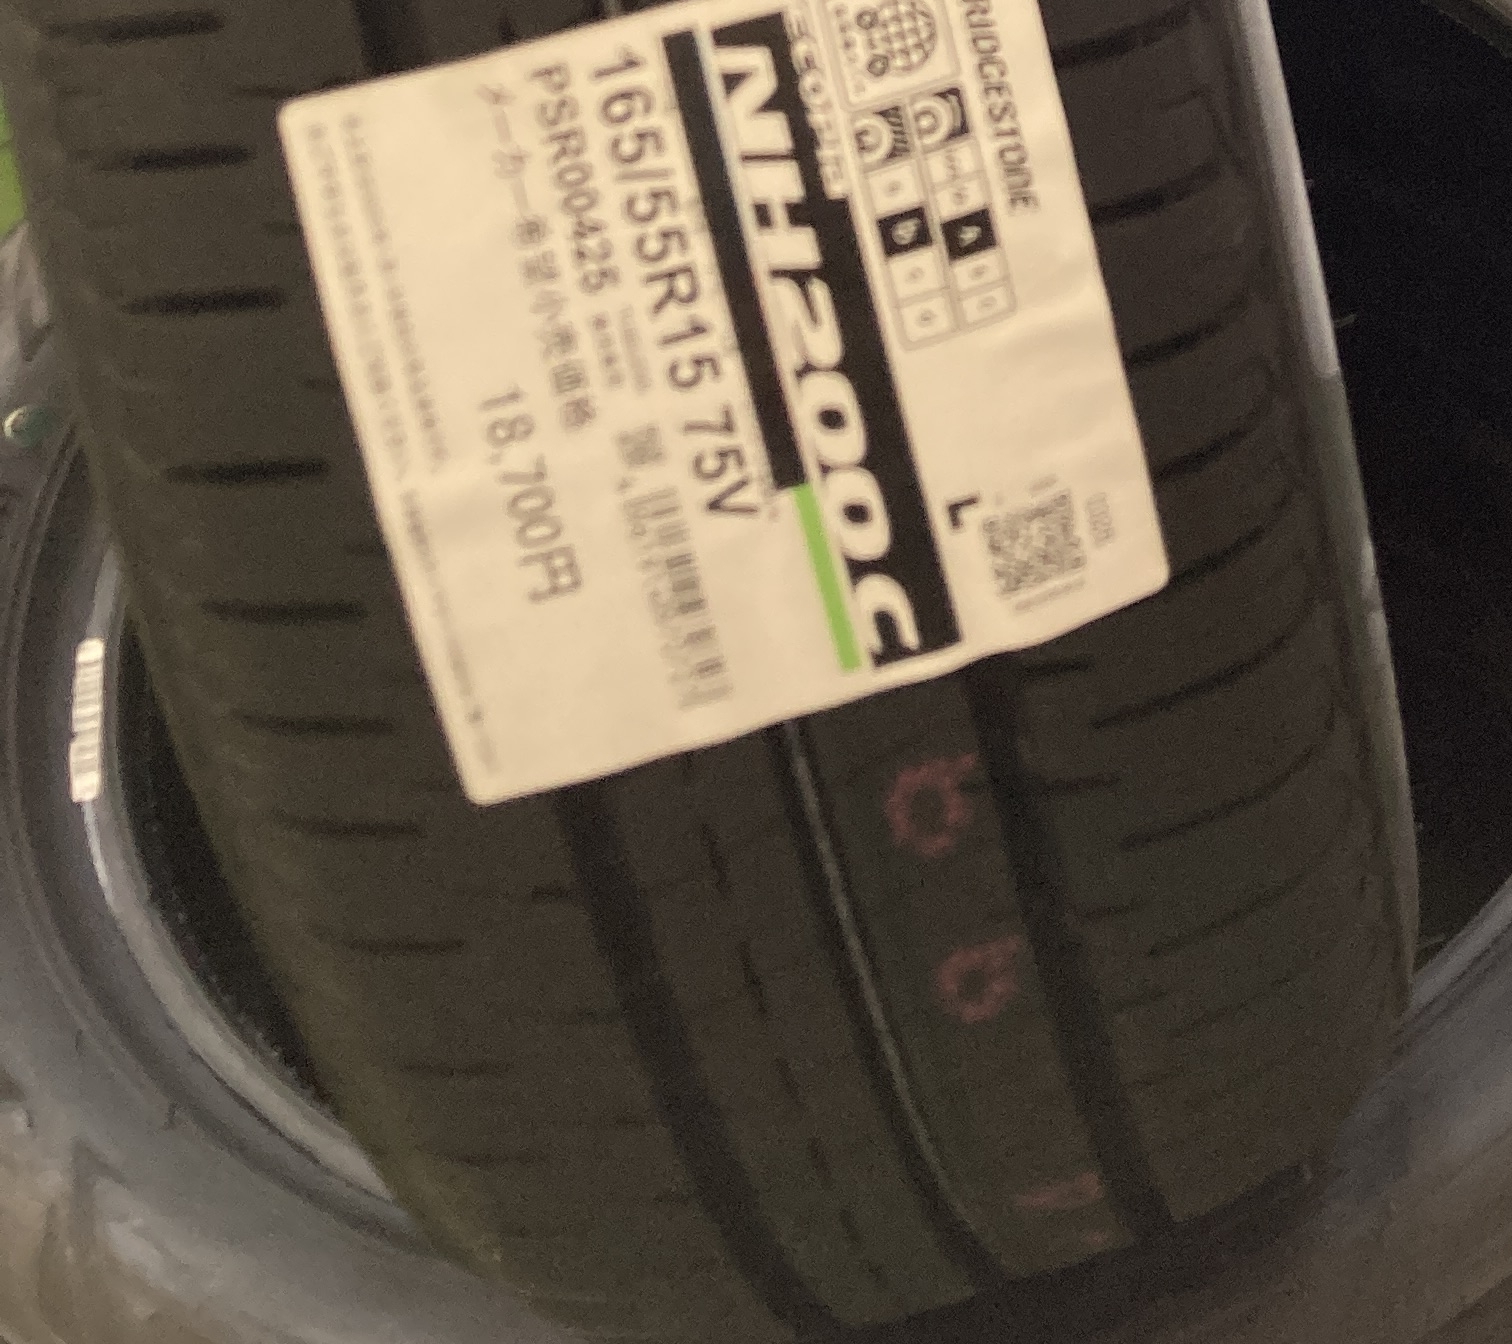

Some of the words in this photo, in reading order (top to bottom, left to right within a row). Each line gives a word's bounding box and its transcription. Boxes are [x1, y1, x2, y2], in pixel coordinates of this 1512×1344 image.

[590, 46, 726, 394] 165/55R15
[682, 408, 760, 520] 75V
[477, 384, 584, 606] 18,700円
[945, 492, 982, 533] L
